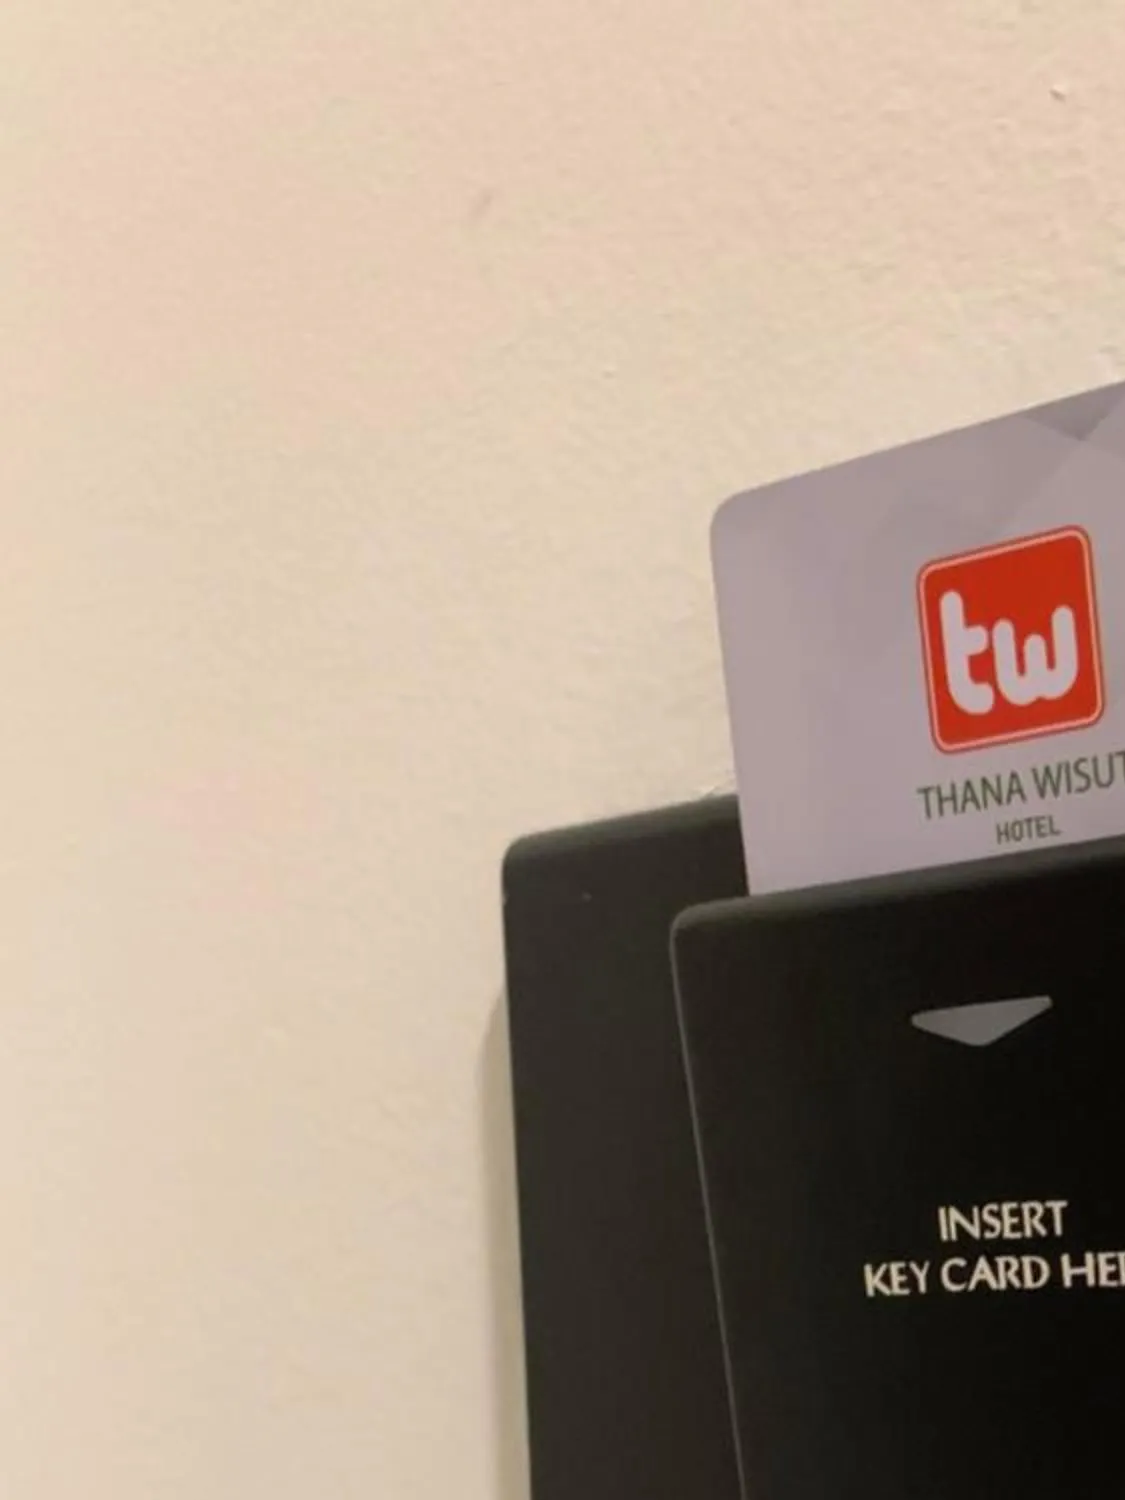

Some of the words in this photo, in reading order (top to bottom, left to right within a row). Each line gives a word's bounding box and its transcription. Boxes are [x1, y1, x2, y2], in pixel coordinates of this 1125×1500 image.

[940, 590, 1078, 714] tw
[917, 772, 1027, 819] THANA
[996, 815, 1061, 844] HOTEL
[938, 1201, 1068, 1242] INSERT
[863, 1261, 930, 1297] KEY
[940, 1255, 1051, 1292] CARD
